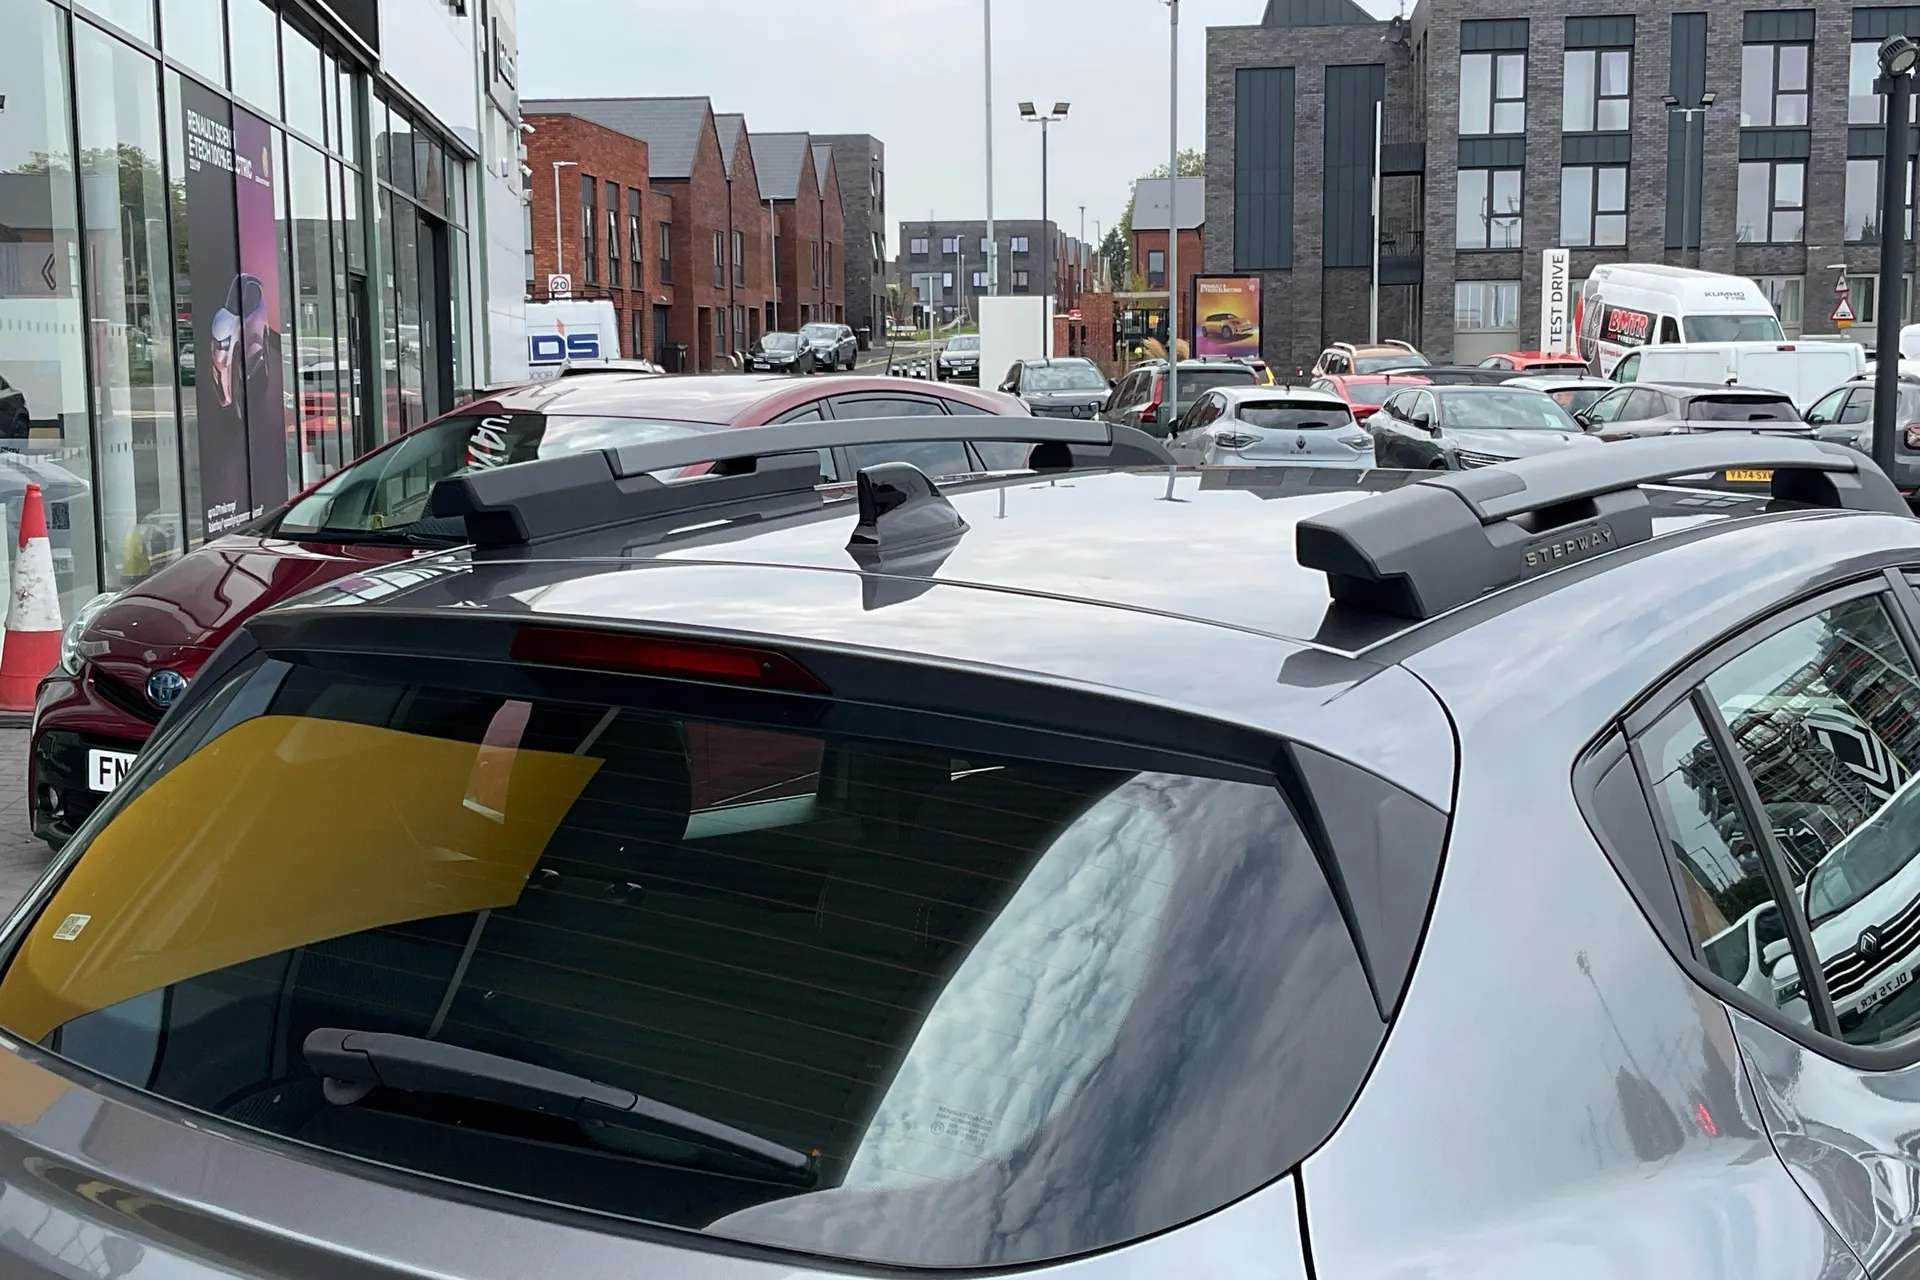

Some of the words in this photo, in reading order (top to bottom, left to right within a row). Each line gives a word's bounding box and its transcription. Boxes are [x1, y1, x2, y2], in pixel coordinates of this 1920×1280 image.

[553, 281, 567, 290] 20
[1551, 255, 1564, 303] DRIVE
[1550, 307, 1562, 345] TEST
[1608, 309, 1649, 338] BMTR
[1526, 528, 1613, 567] STEPWAY
